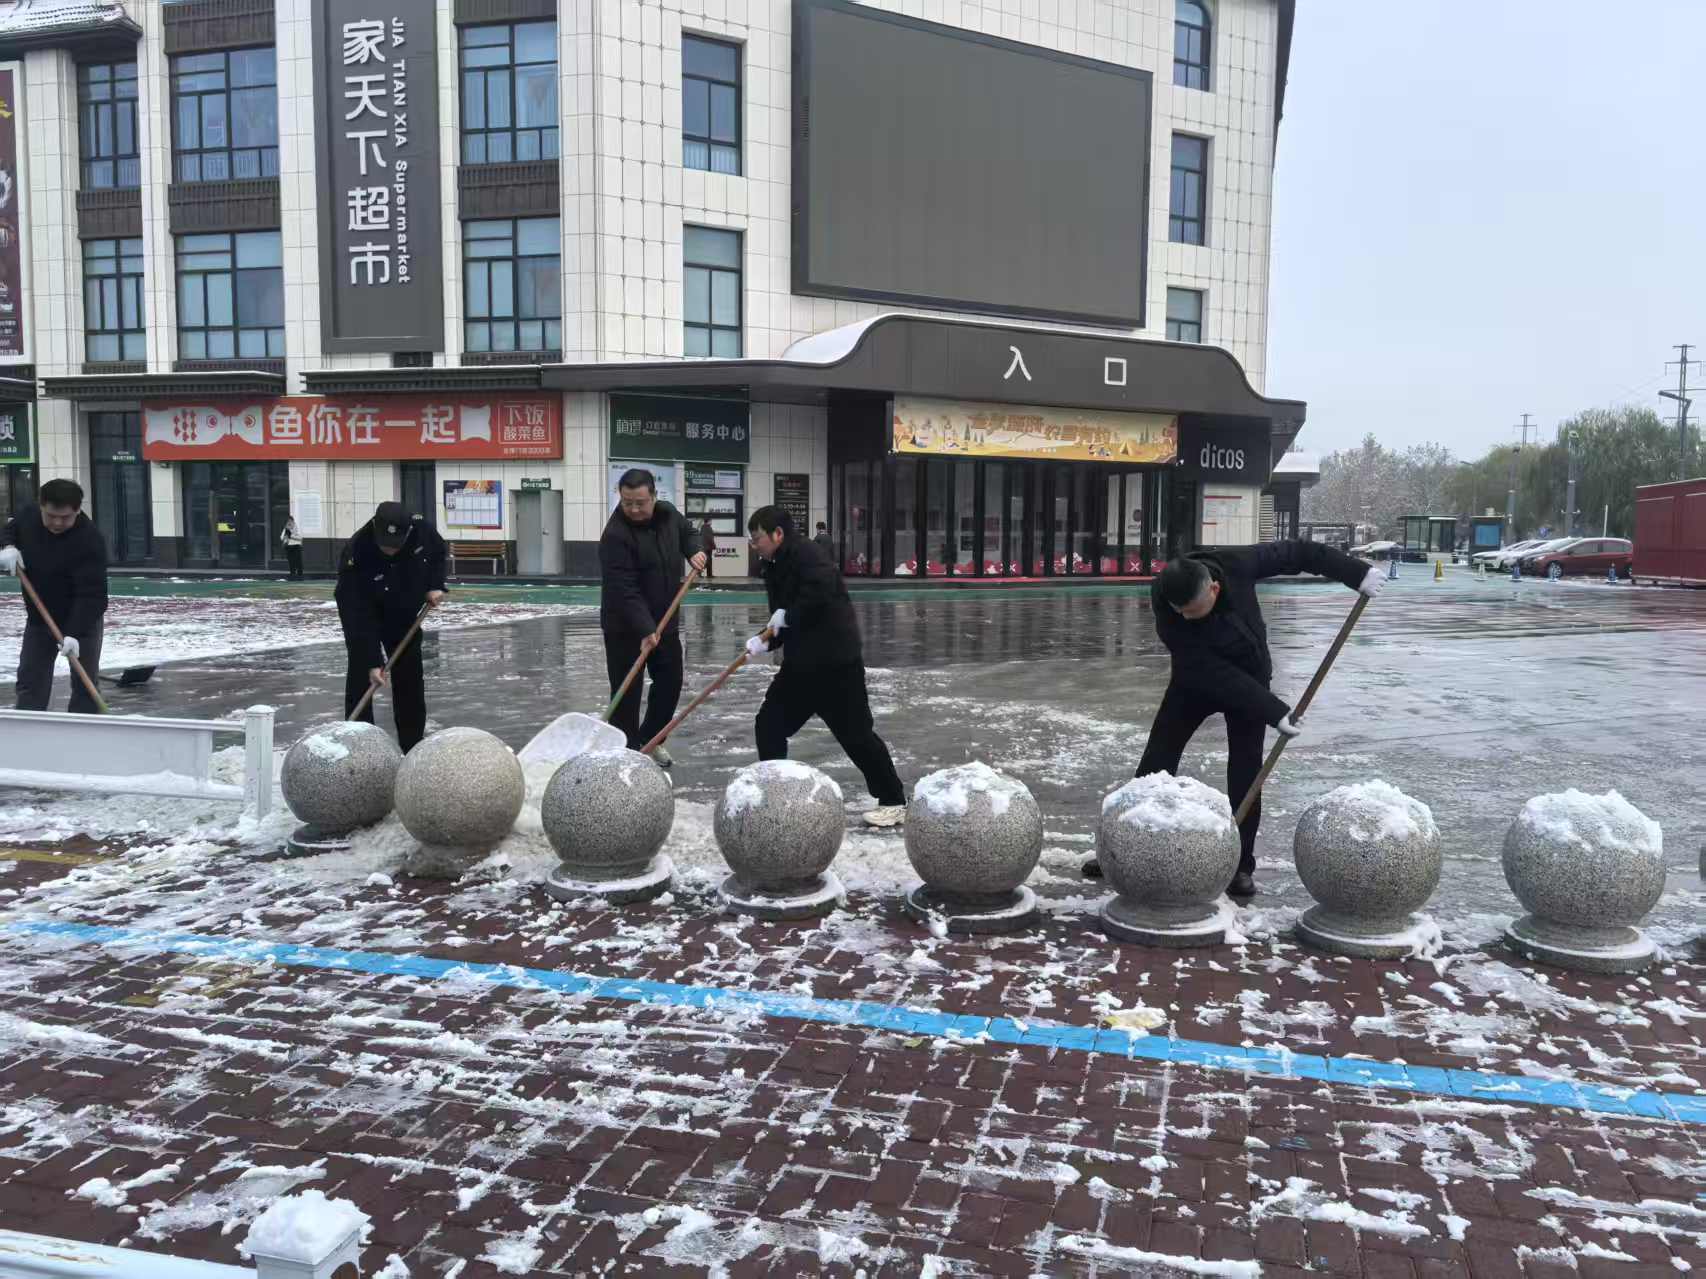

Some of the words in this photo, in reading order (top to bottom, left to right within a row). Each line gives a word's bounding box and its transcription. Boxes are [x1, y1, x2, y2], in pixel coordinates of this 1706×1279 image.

[391, 16, 405, 48] JIA
[392, 58, 407, 106] TIAN
[394, 112, 408, 148] XIA
[342, 18, 391, 286] 家天下超市
[393, 159, 411, 283] Supermarket
[1003, 345, 1127, 386] 入口
[268, 404, 456, 445] 鱼你在一起
[503, 405, 545, 425] 下饭
[503, 425, 546, 441] 酸菜鱼
[685, 421, 745, 441] 服务中心
[1200, 443, 1245, 470] dicos
